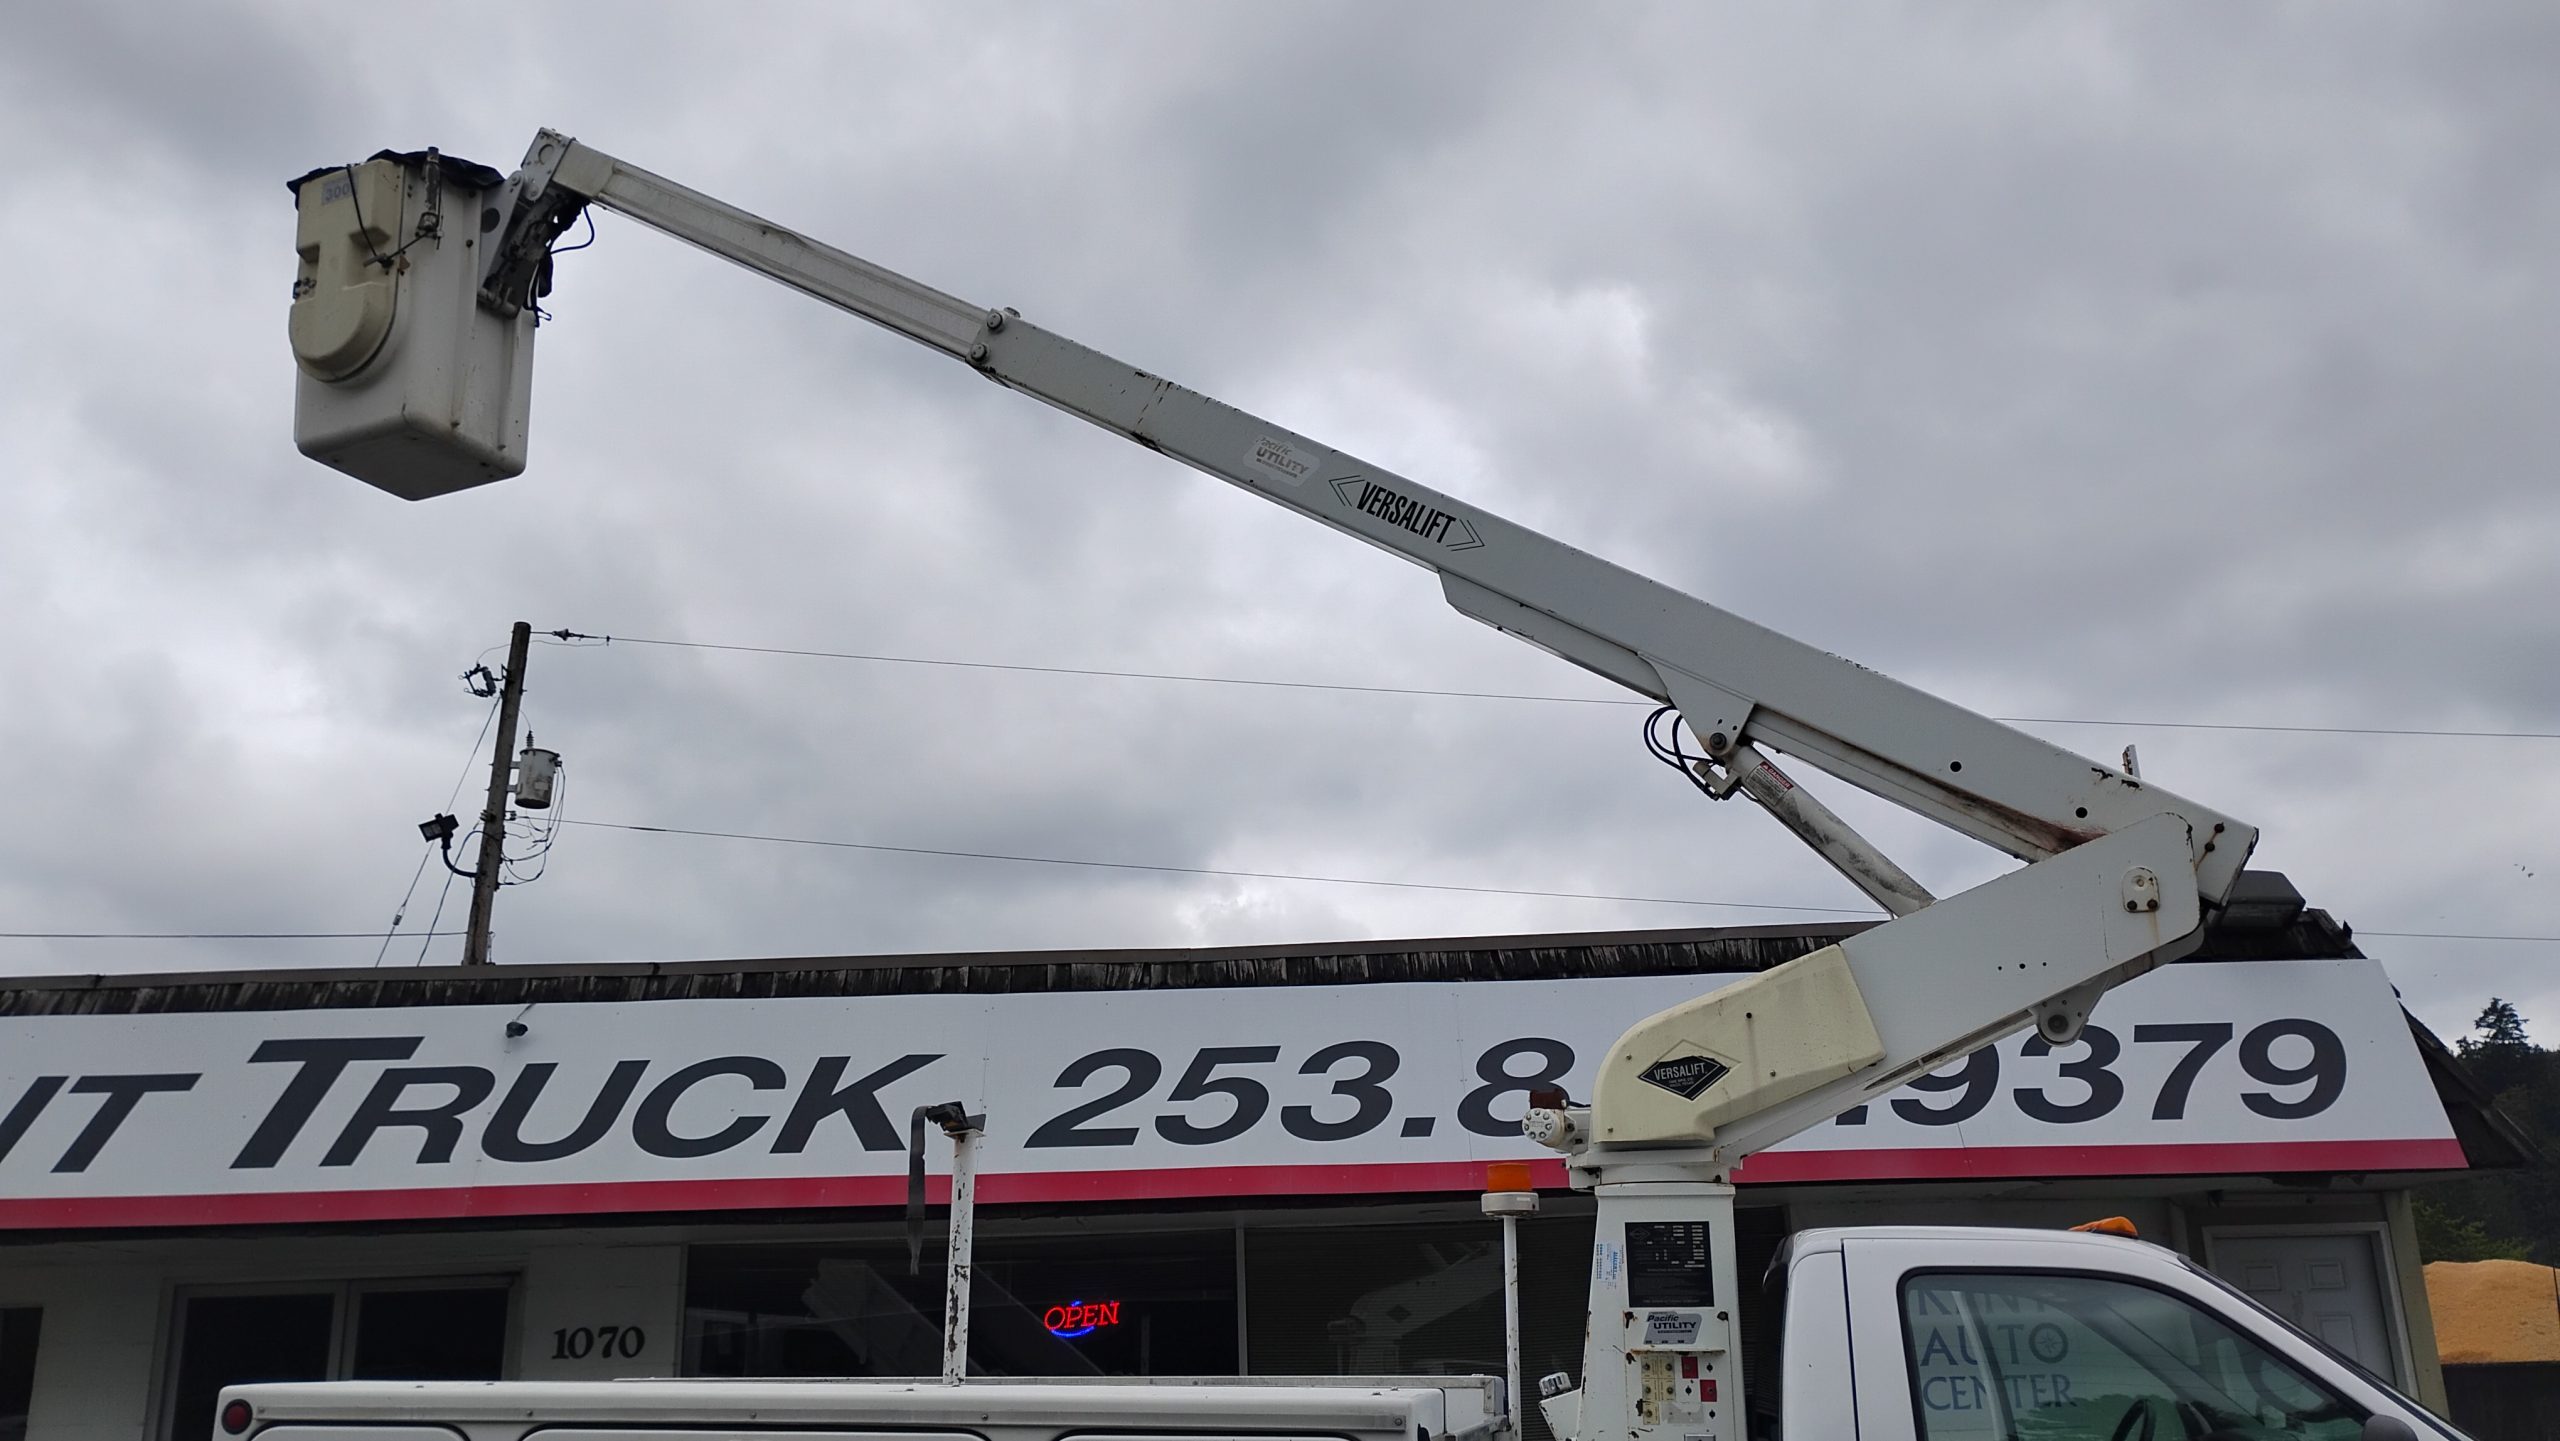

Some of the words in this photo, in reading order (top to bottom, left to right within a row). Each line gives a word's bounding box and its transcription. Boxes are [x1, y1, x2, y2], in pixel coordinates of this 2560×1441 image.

[1256, 447, 1310, 474] UTILITY
[1357, 482, 1456, 544] VERSALIFT
[1768, 769, 1791, 788] DANGER
[1654, 1063, 1706, 1081] VERSALIFT
[229, 1036, 947, 1169] TRUCK
[1043, 1302, 1120, 1331] OPEN
[1647, 1314, 1679, 1322] Pacific
[1654, 1322, 1697, 1330] UTILITY
[551, 1326, 645, 1359] 1070
[1920, 1322, 2069, 1367] AUTO
